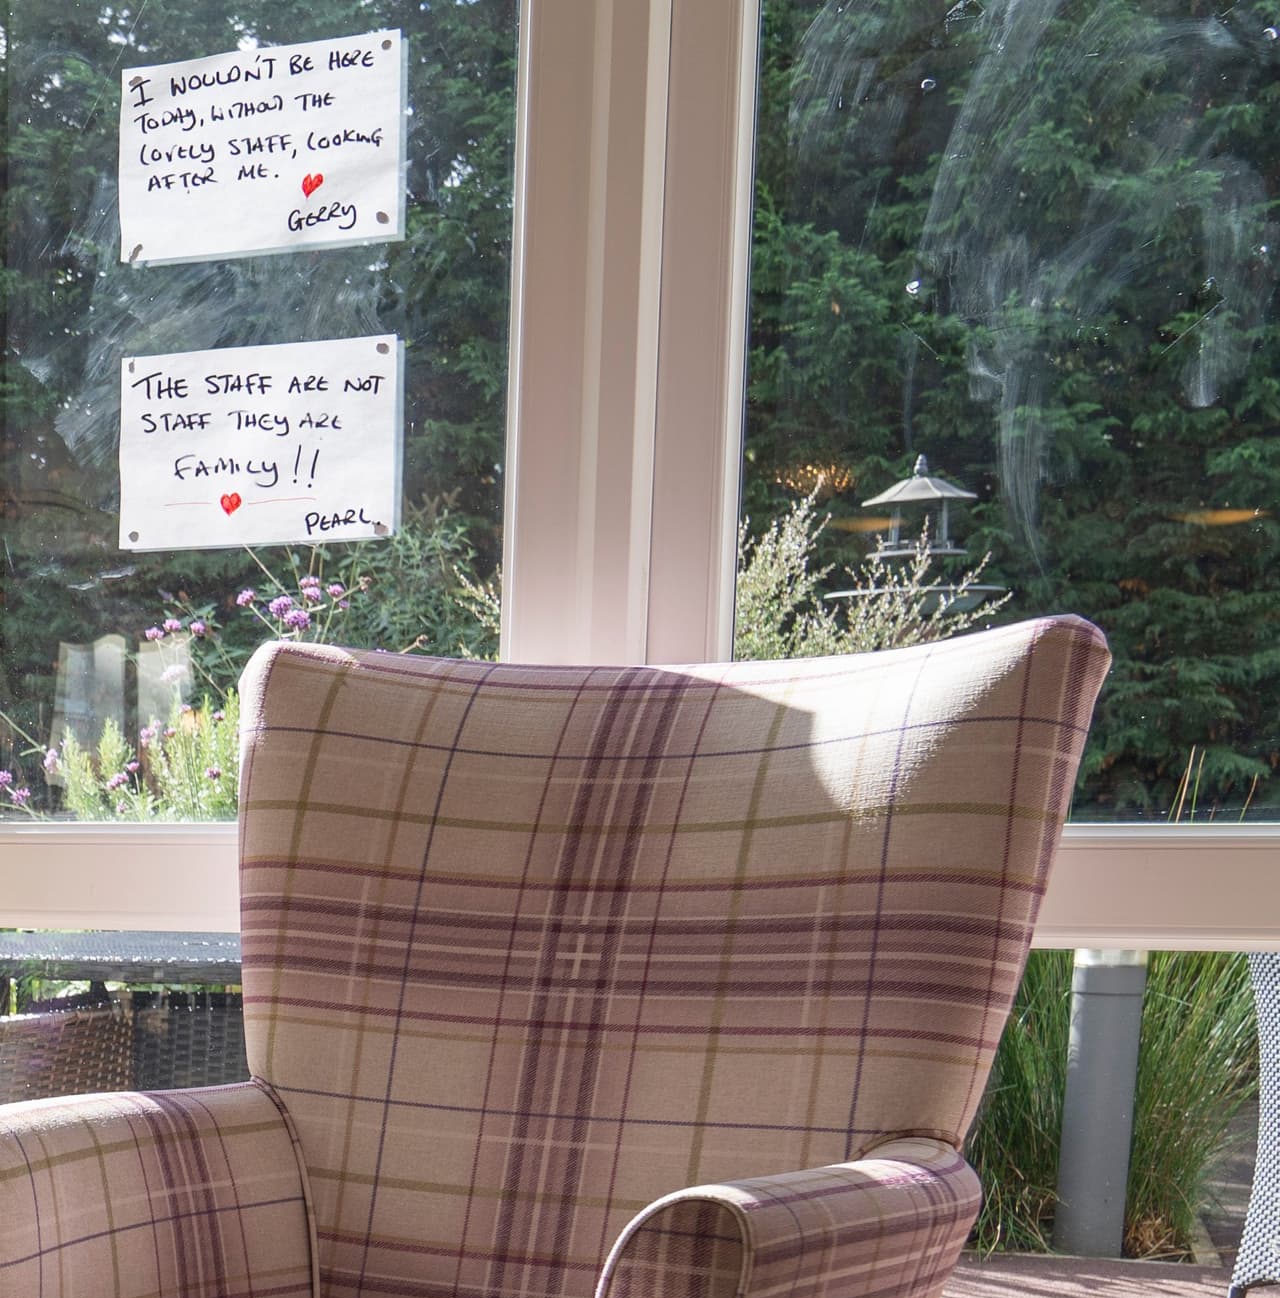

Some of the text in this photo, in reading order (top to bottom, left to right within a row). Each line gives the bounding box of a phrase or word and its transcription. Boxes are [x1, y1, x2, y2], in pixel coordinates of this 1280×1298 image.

[130, 80, 154, 108] I
[290, 55, 314, 75] BE
[329, 50, 374, 71] HERE
[295, 93, 336, 111] THE
[148, 167, 218, 192] AFTER
[132, 372, 385, 400] THE STAFF ARE NOT
[141, 410, 342, 436] STAFF THEY ARE
